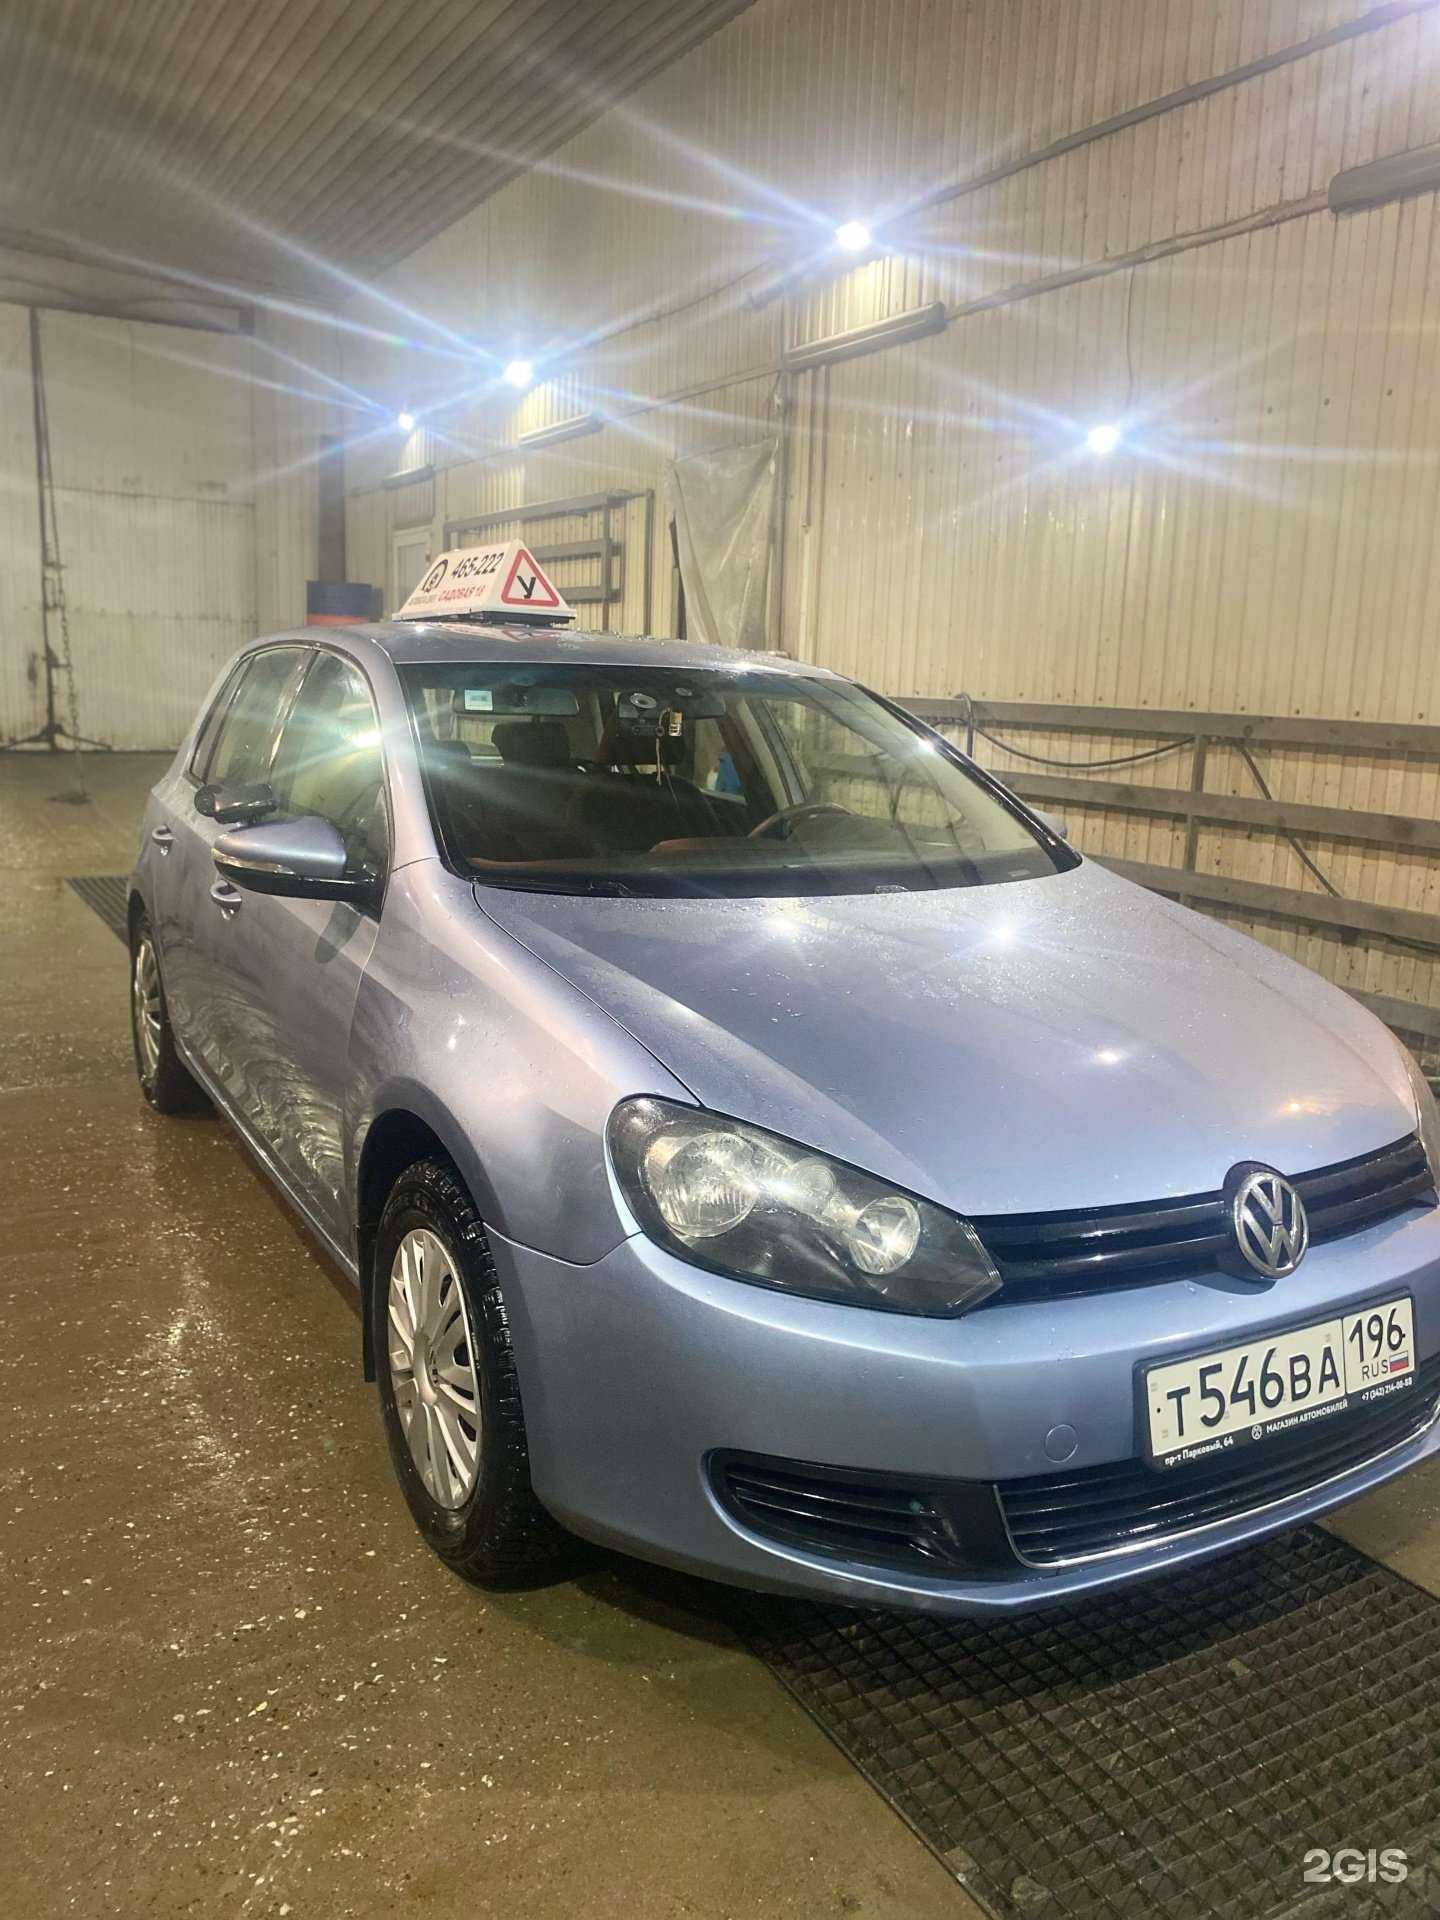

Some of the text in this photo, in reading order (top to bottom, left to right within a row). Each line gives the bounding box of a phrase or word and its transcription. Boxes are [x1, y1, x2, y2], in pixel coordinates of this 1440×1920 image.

[452, 552, 505, 579] 465-222
[517, 575, 536, 599] У
[1348, 1308, 1404, 1363] 196
[1361, 1358, 1389, 1381] RUS
[1266, 1398, 1348, 1434] МАГАЗИН АВТОМОБИЛЕЙ
[1182, 1440, 1223, 1460] Парковый,
